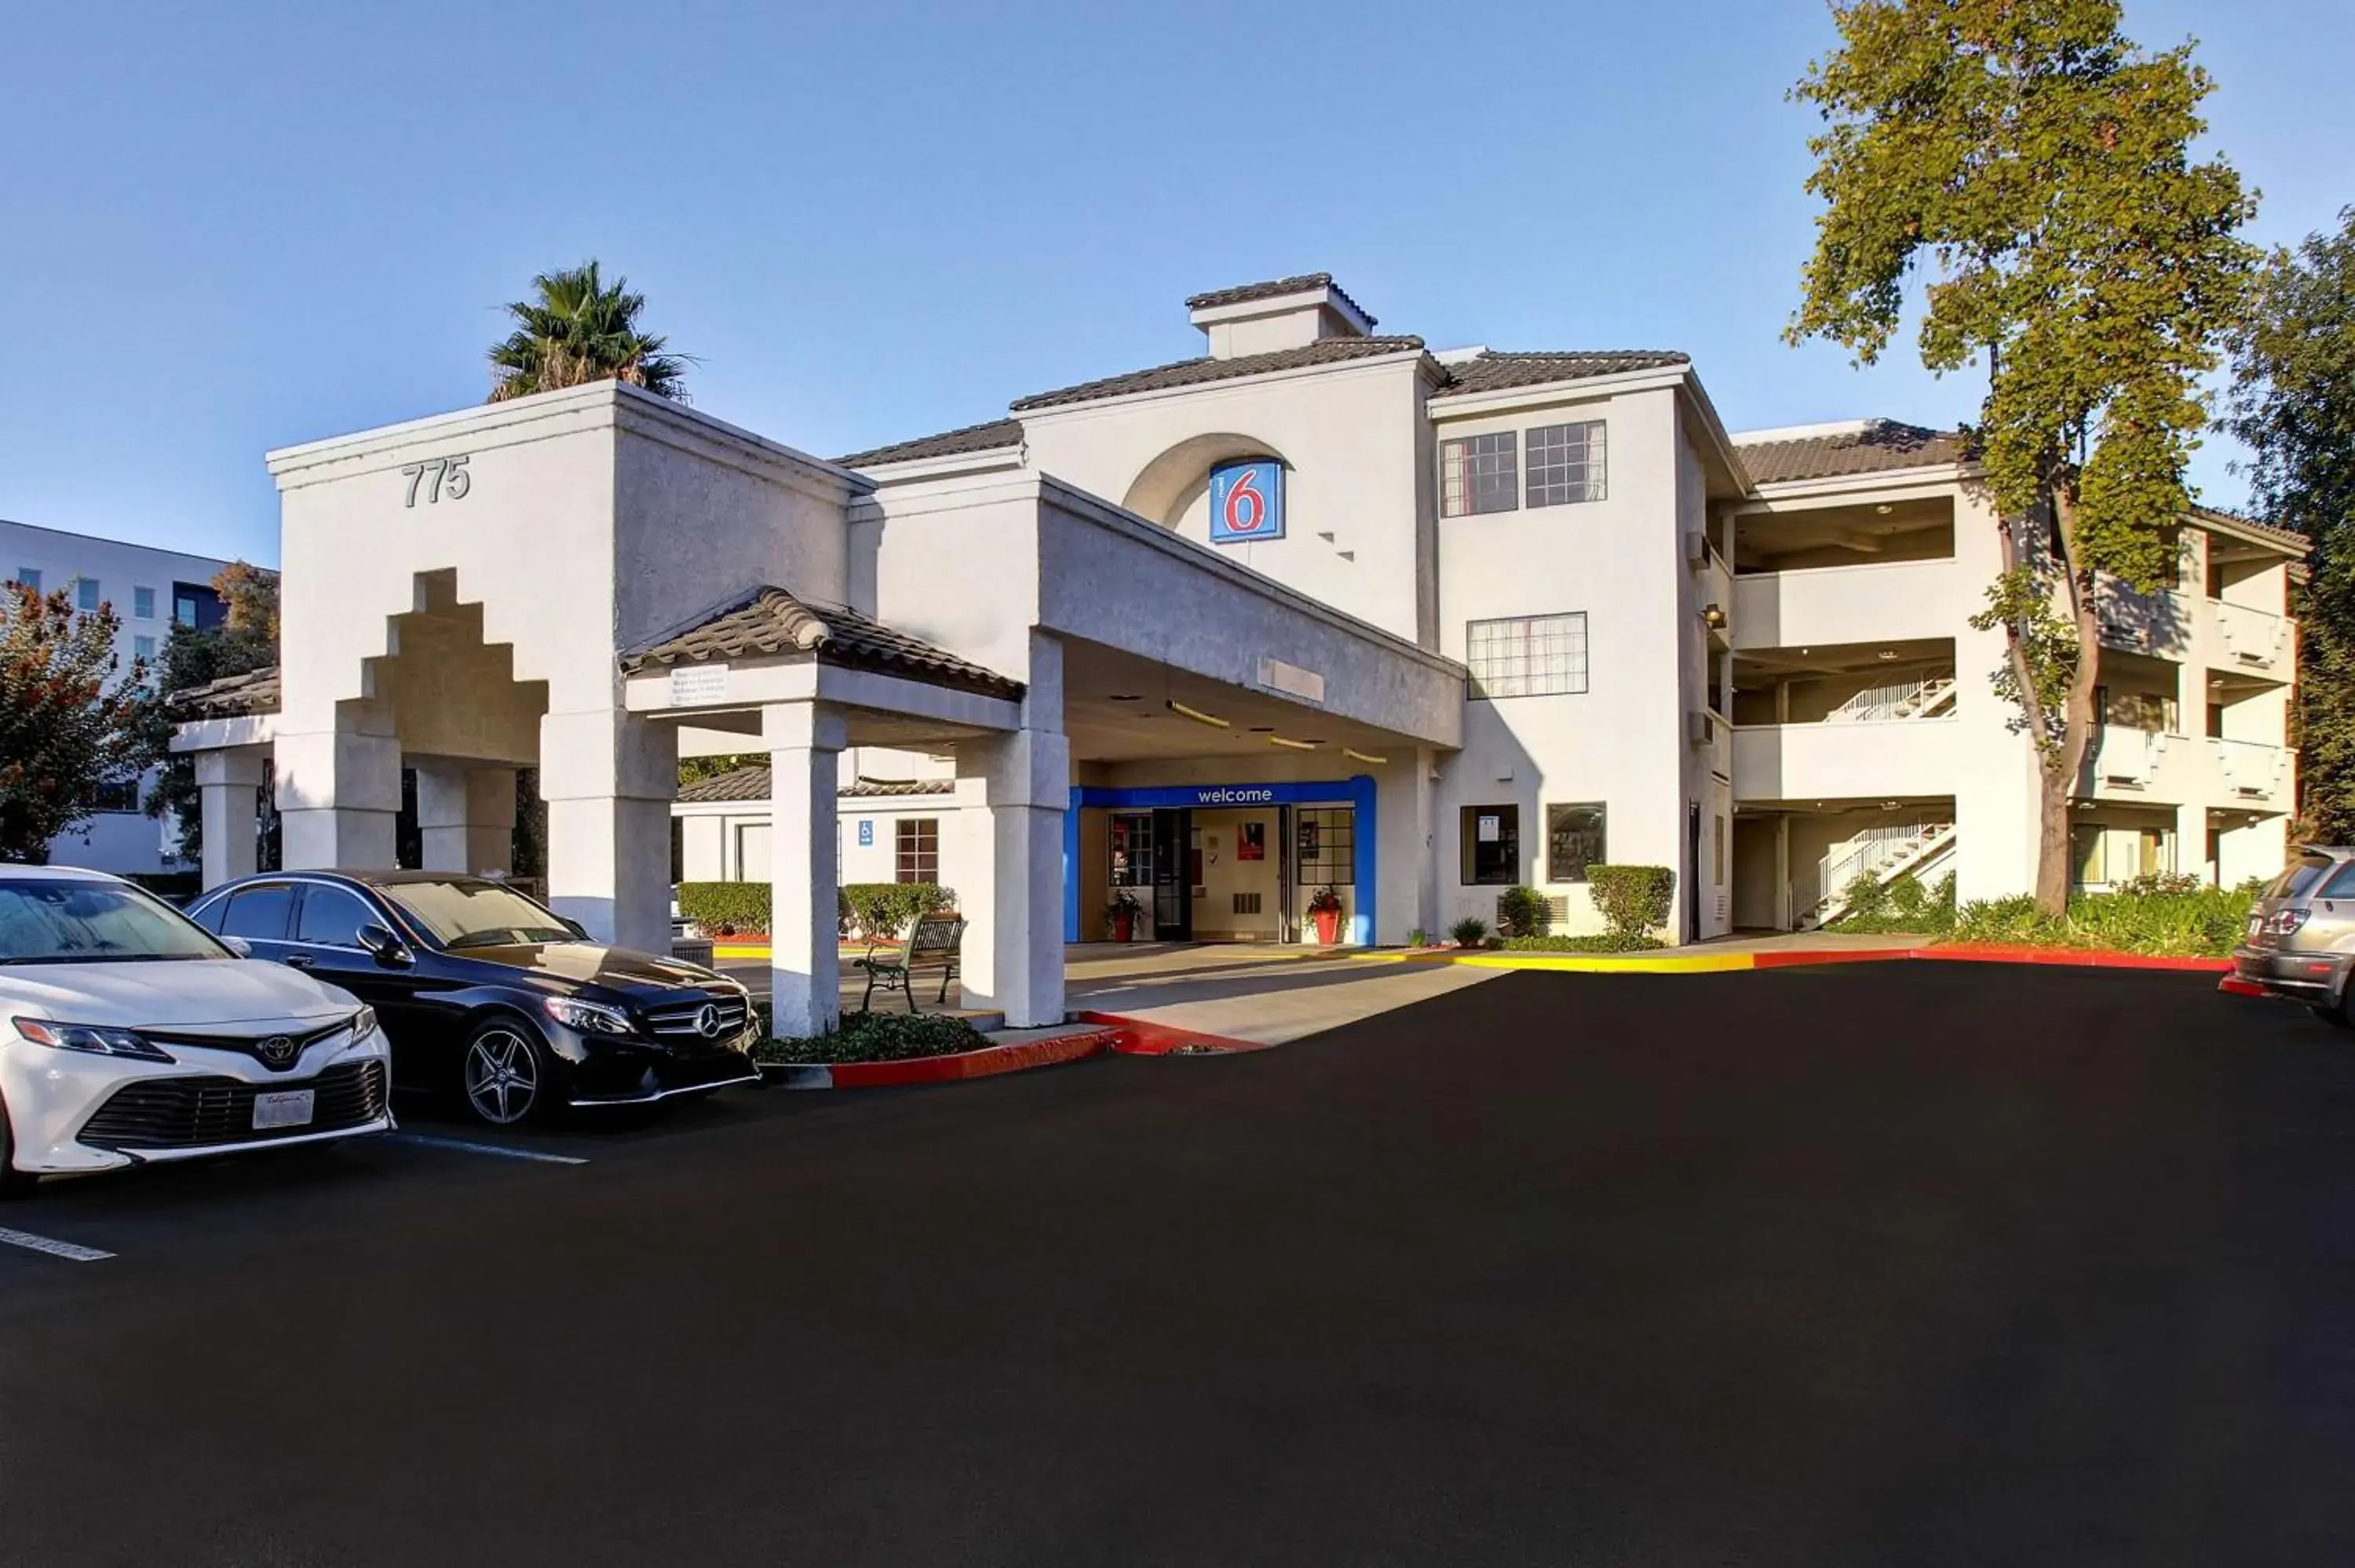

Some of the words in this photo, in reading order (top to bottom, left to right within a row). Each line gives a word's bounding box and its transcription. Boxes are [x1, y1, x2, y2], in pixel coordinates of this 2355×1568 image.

[402, 455, 470, 508] 775
[1224, 469, 1265, 533] 6
[1198, 787, 1272, 802] welcome
